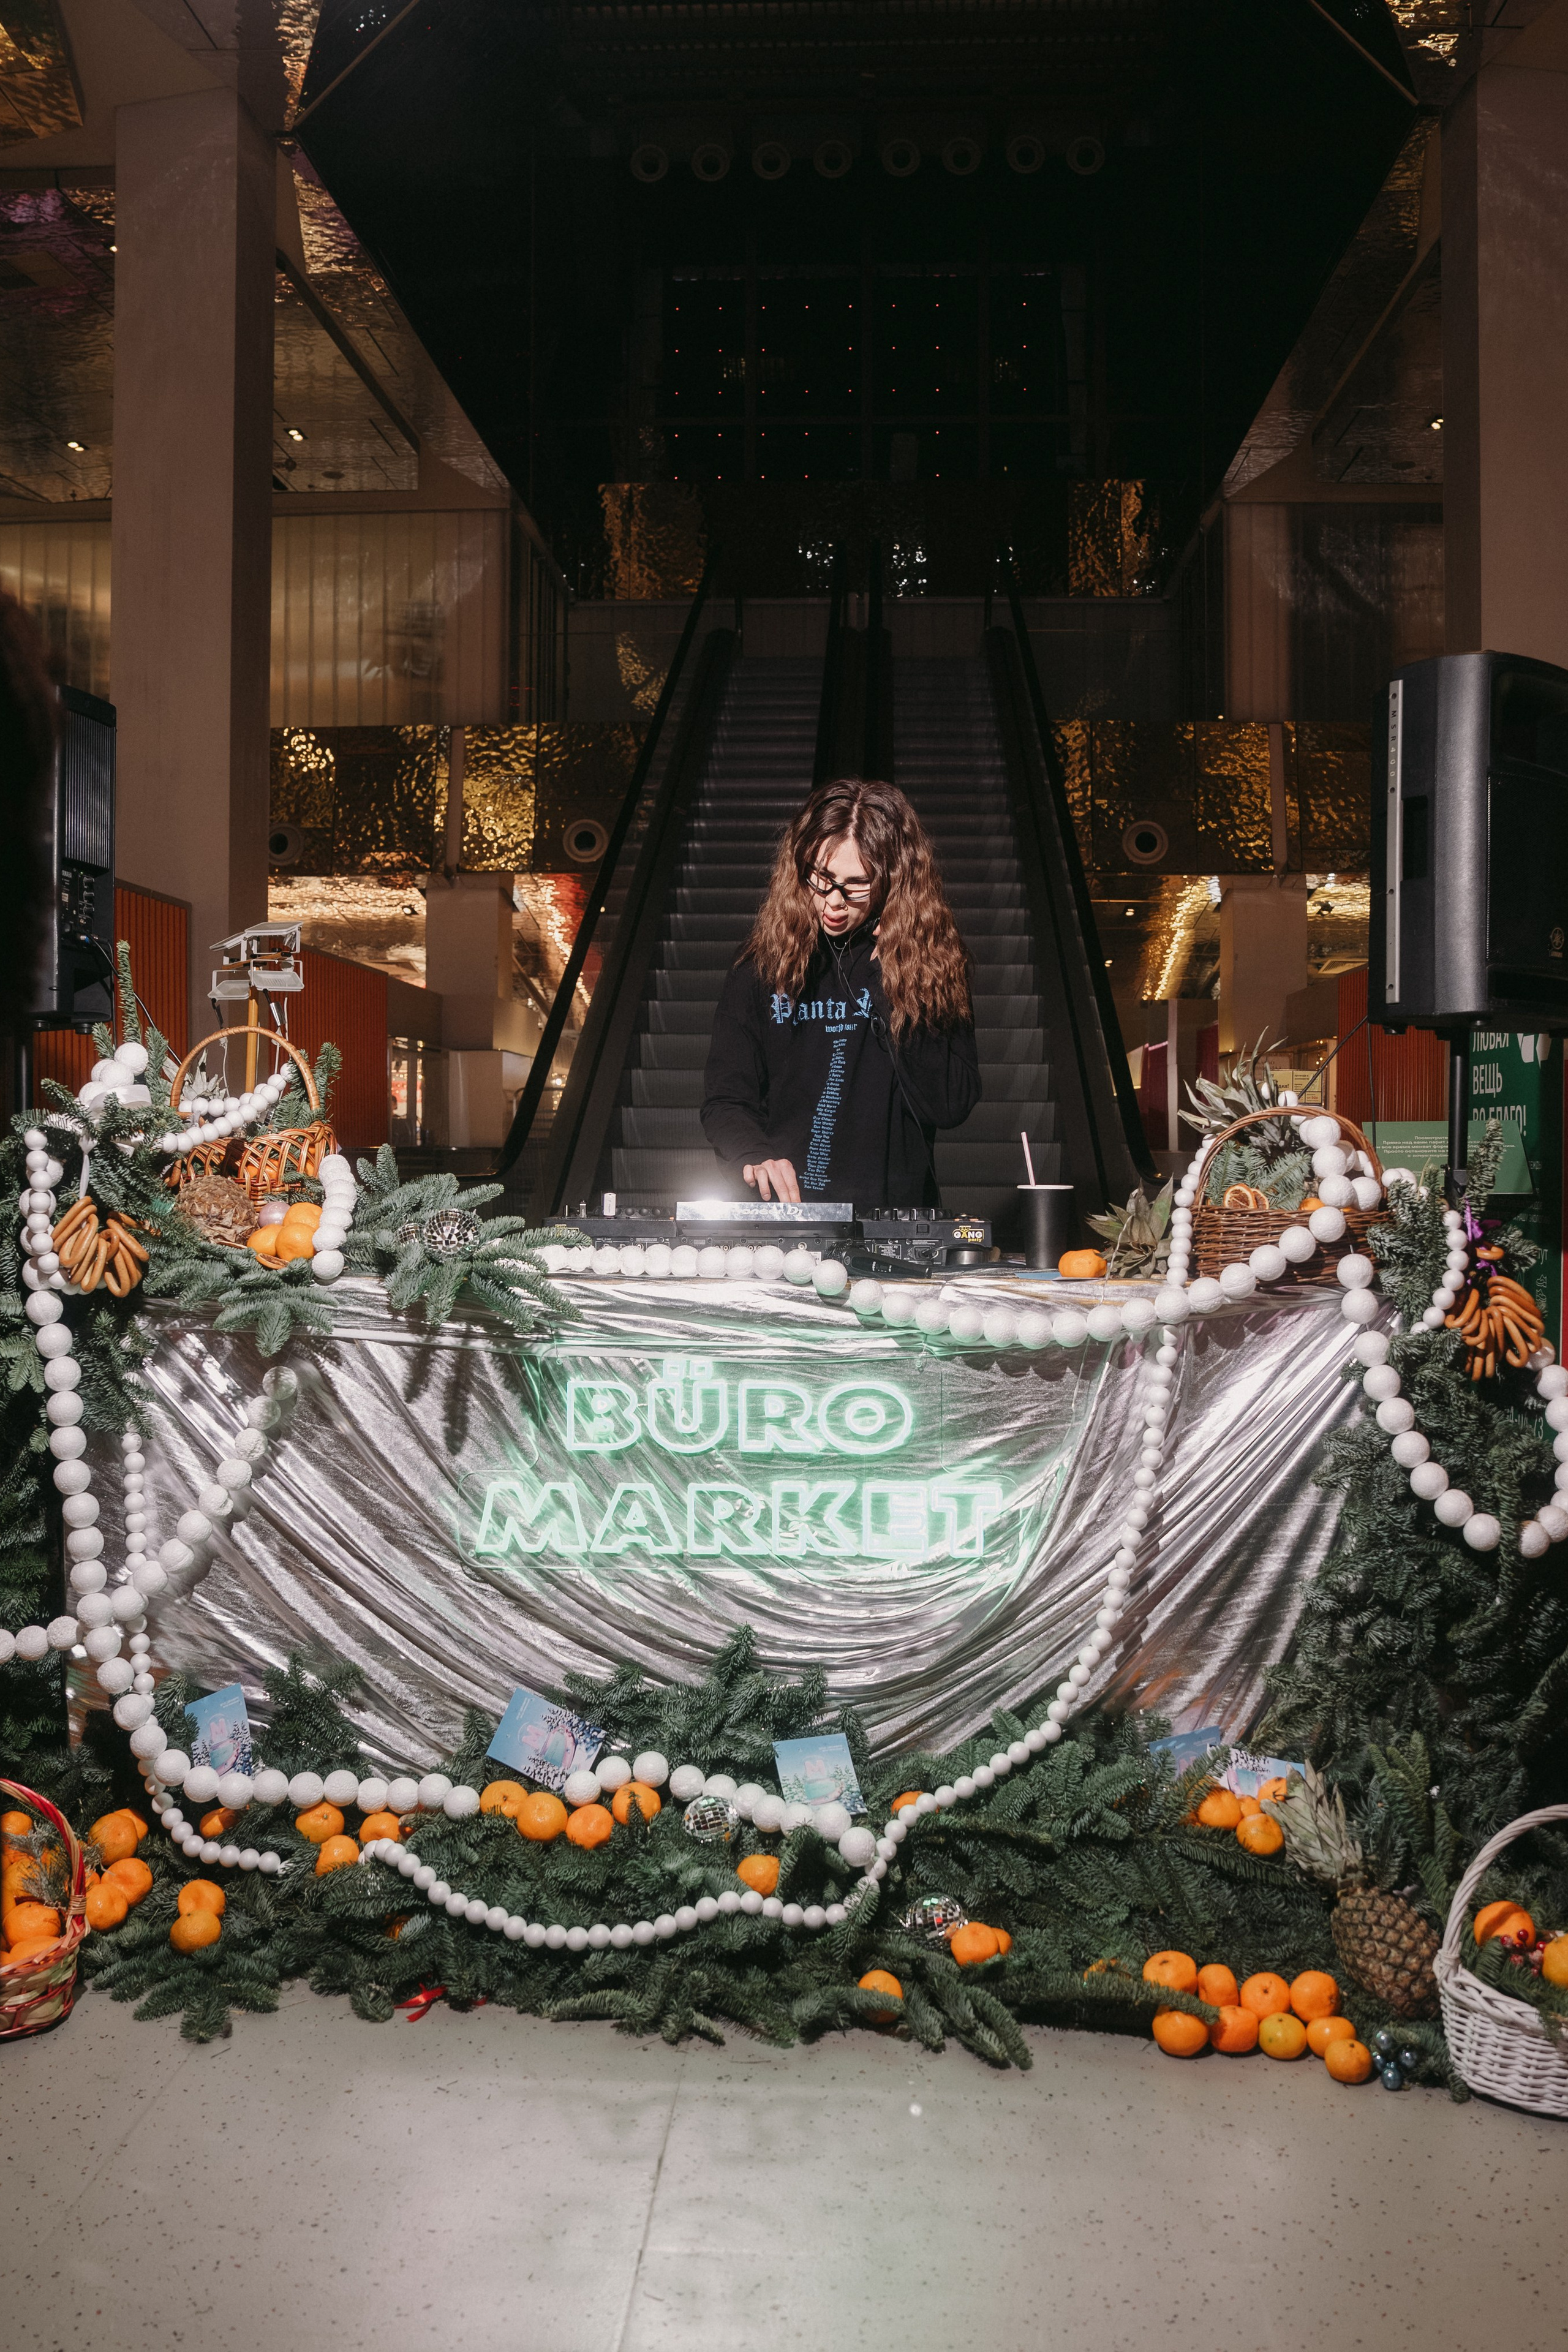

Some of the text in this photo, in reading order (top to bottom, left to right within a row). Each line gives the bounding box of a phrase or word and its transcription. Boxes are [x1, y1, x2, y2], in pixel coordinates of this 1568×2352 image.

[770, 993, 846, 1026] Panta
[825, 1023, 844, 1033] world
[1472, 1063, 1502, 1098] ВЕЩЬ
[729, 1205, 783, 1216] ioneer
[567, 1359, 914, 1455] BÜRO
[477, 1480, 1003, 1559] MARKET
